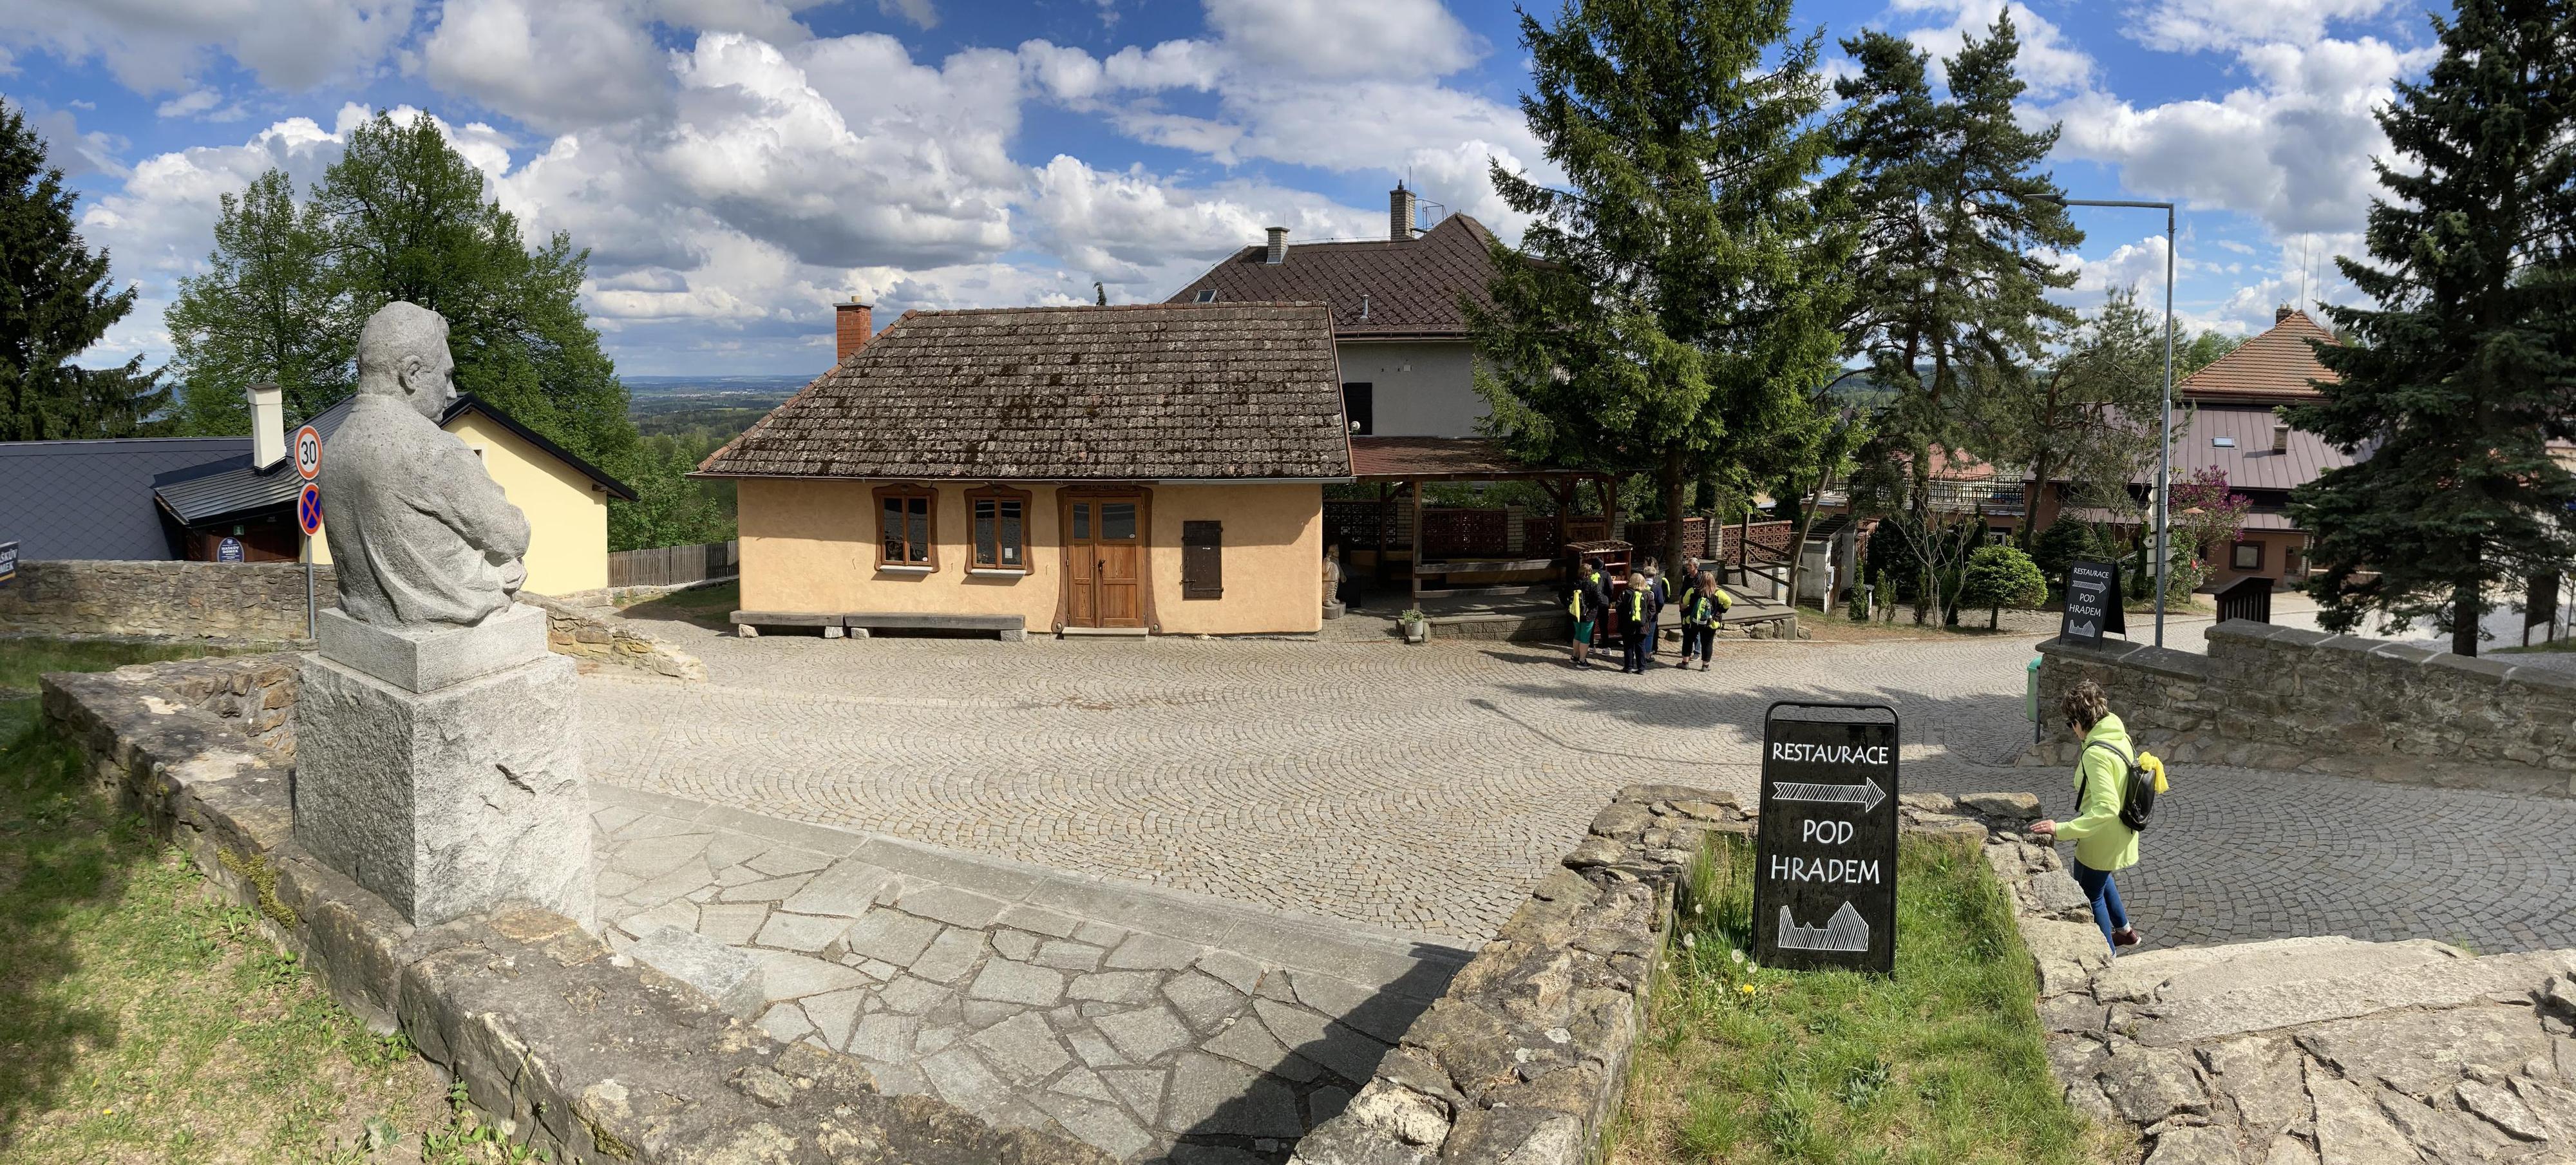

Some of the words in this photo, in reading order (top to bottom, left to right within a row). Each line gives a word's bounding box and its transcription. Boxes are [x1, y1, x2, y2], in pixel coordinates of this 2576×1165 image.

[301, 440, 317, 465] 30
[2074, 567, 2109, 578] RESTAURACE
[2079, 593, 2095, 603] POD
[2069, 603, 2101, 616] HRADEM
[1772, 742, 1889, 764] RESTAURACE
[1803, 819, 1853, 844] POD
[1771, 854, 1880, 884] HRADEM
